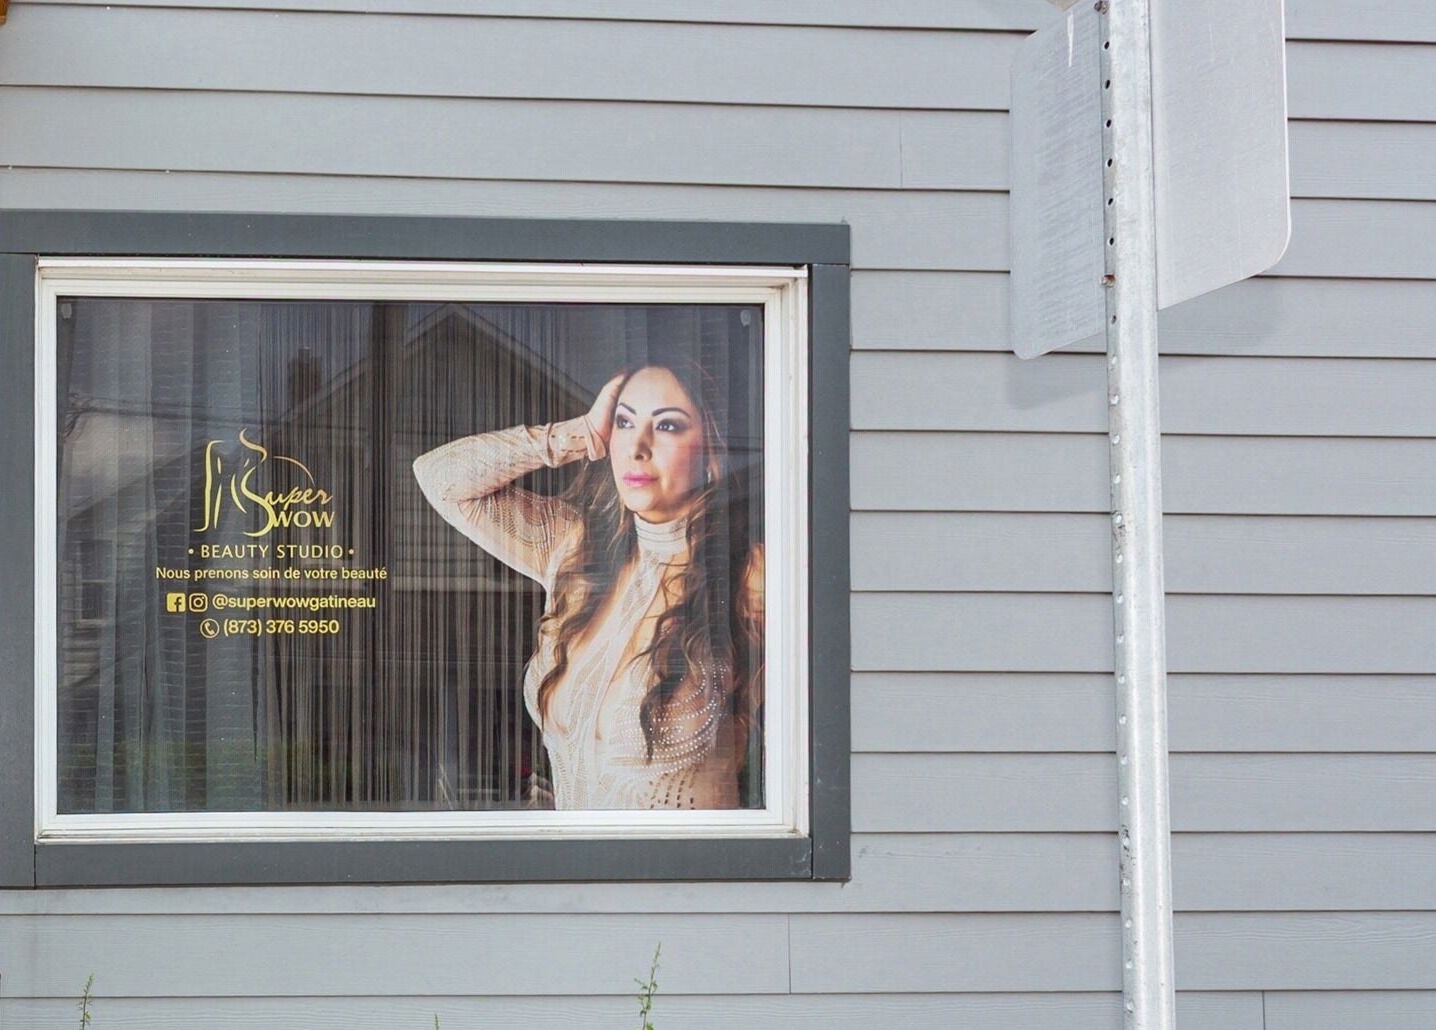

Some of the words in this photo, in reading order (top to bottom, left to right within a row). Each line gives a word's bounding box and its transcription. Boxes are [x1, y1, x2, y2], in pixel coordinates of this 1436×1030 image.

[241, 466, 334, 537] Super
[272, 510, 335, 528] WOW
[201, 545, 269, 558] BEAUTY
[277, 545, 344, 559] STUDIO
[156, 567, 191, 579] Nous
[194, 569, 249, 581] prenons
[253, 566, 280, 579] soin
[284, 567, 301, 579] de
[304, 568, 338, 579] votre
[341, 566, 388, 579] beauté
[212, 594, 376, 611] @superwowgatineau
[224, 619, 262, 637] (873)
[266, 620, 295, 634] 376
[298, 620, 340, 634] 5950
